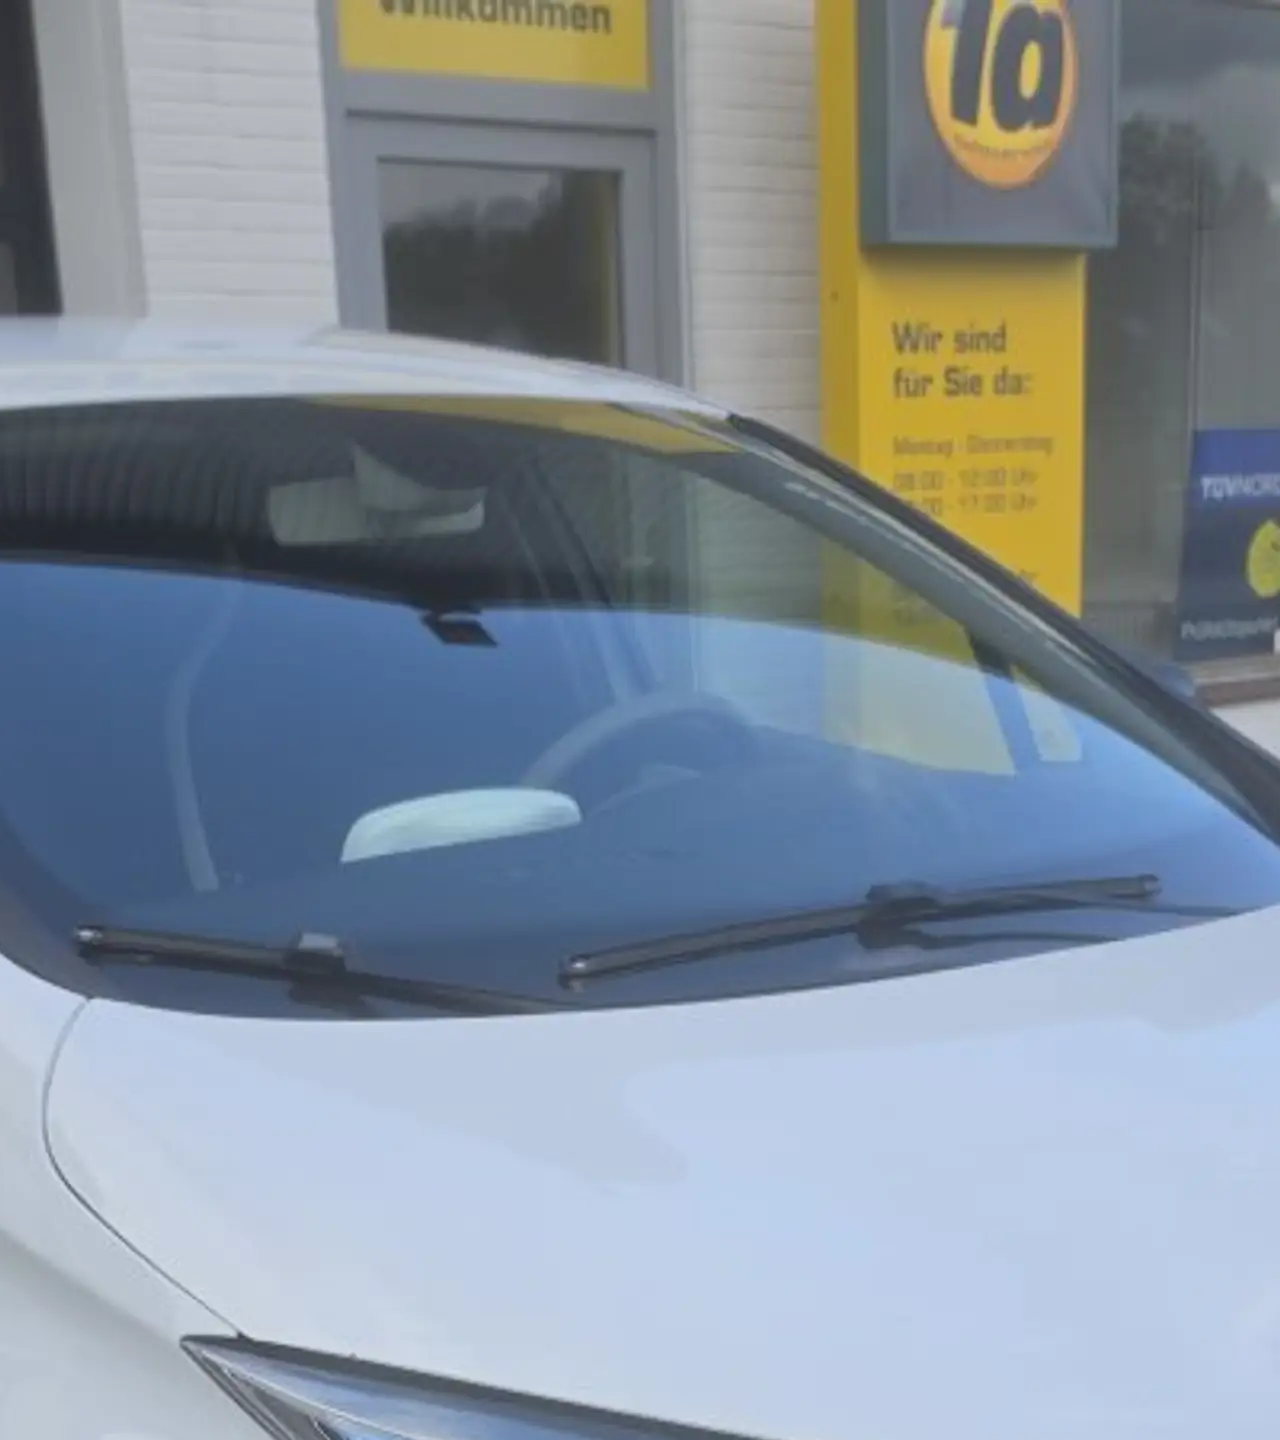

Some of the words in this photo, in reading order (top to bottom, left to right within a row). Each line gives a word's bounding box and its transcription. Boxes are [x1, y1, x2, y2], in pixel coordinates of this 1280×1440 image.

[892, 320, 944, 355] Wir
[953, 317, 1007, 354] sind
[892, 366, 933, 399] für
[942, 363, 982, 398] Sie
[992, 364, 1035, 396] da:
